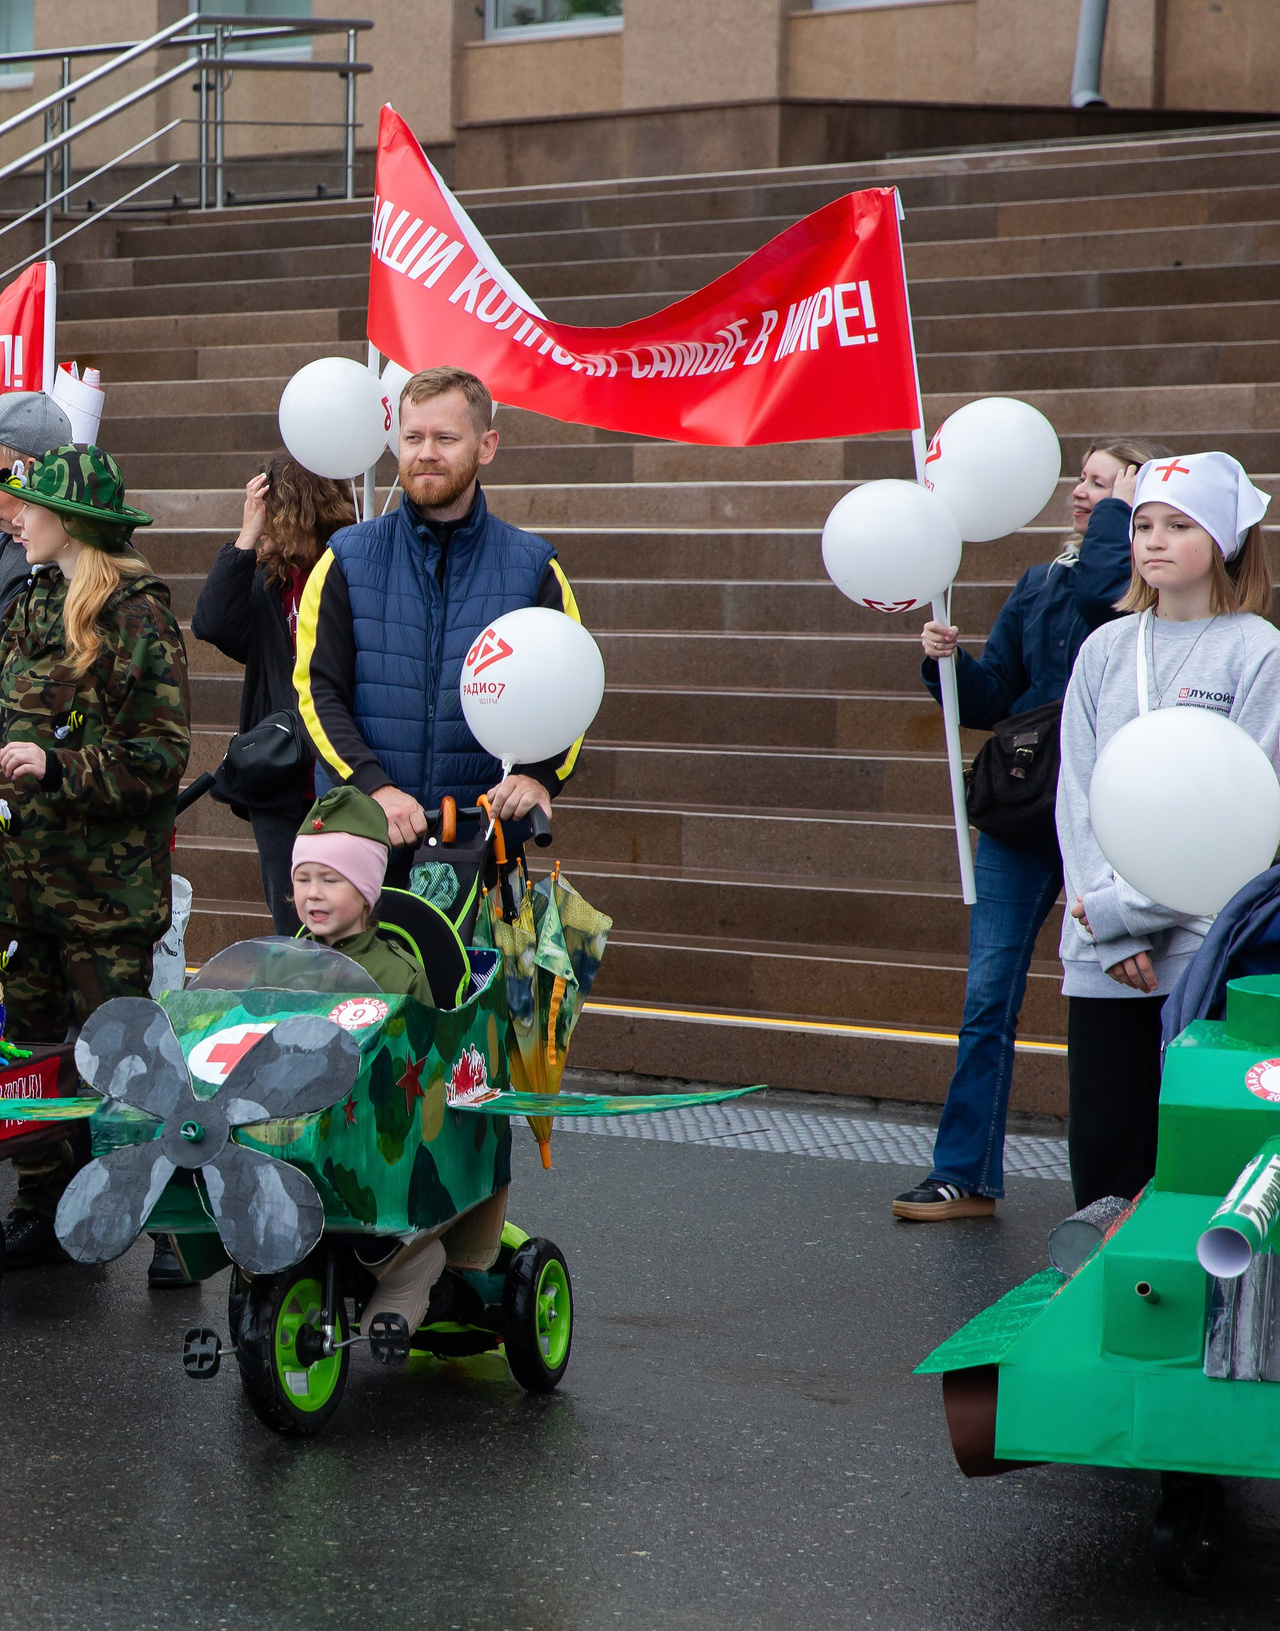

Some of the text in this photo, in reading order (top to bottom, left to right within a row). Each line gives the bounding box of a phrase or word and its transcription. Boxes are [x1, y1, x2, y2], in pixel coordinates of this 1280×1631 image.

[629, 318, 749, 378] САМЫЕ
[743, 309, 779, 366] В
[774, 279, 879, 363] МИРЕ!
[463, 682, 506, 699] РАДИО7
[349, 1008, 366, 1021] 9
[1247, 1060, 1274, 1092] ПАРАД
